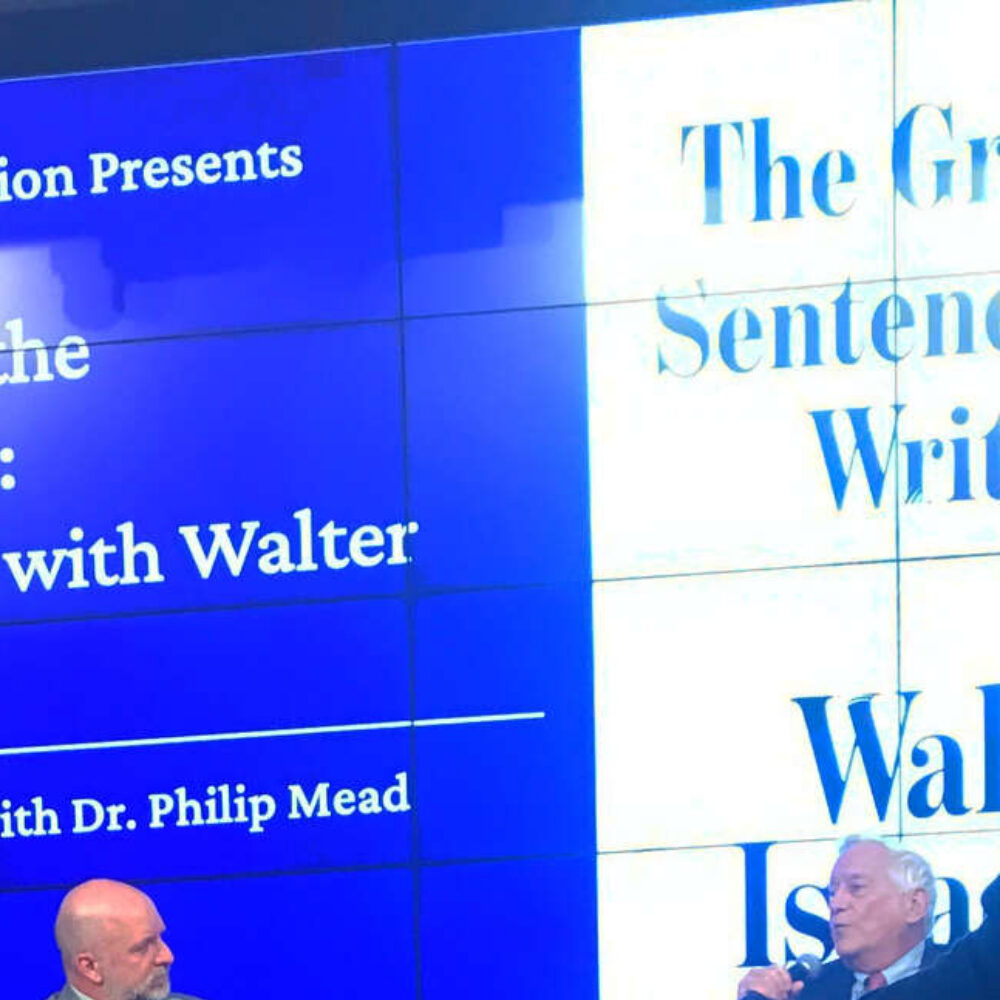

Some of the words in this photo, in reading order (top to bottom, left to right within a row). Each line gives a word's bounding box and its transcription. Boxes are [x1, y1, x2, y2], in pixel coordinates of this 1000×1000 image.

[89, 142, 304, 194] Presents
[681, 116, 857, 225] The
[1, 521, 165, 593] with
[178, 507, 420, 579] Walter
[71, 798, 138, 833] Dr.
[148, 783, 276, 833] Philip
[288, 771, 412, 819] Mead
